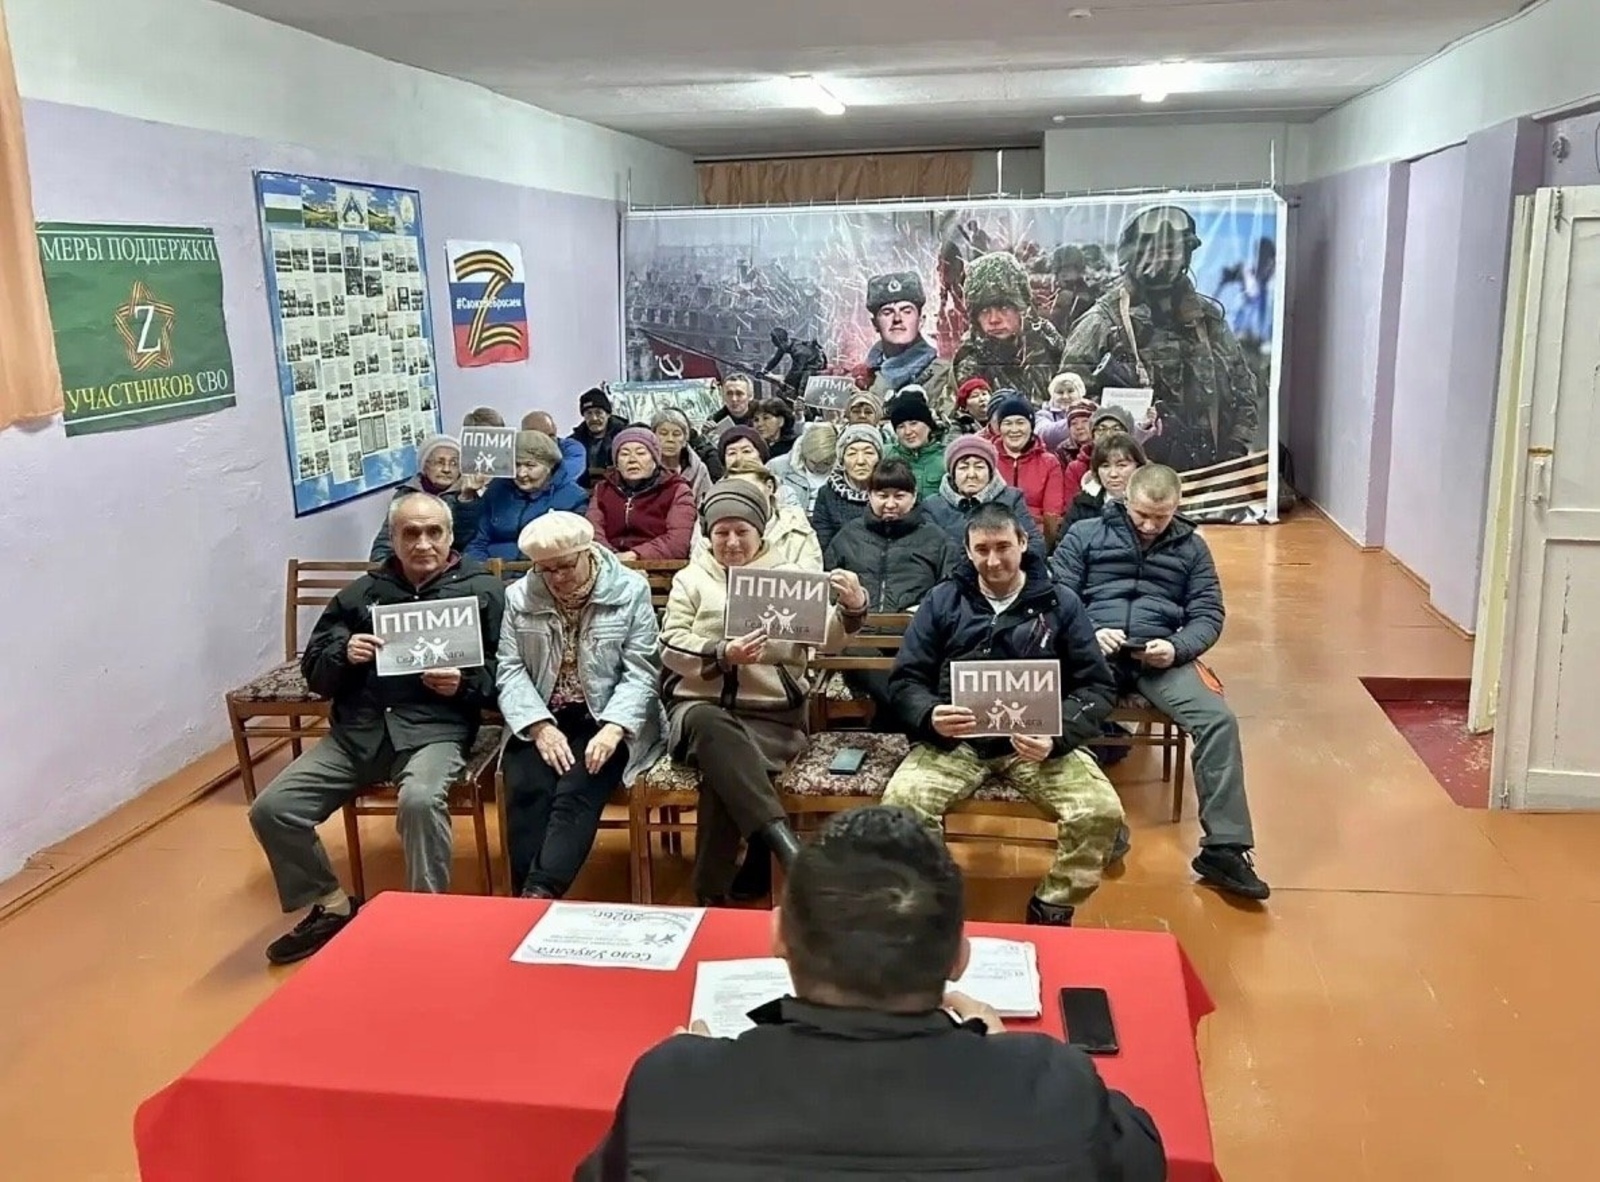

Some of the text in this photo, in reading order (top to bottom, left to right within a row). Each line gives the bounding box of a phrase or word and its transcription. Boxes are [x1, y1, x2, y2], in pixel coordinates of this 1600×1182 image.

[41, 237, 216, 265] МЕРЫ ПОДДЕРЖКИ
[134, 305, 161, 353] Z
[66, 369, 228, 413] УЧАСТНИКОВ СВО
[463, 431, 512, 449] ППМИ
[735, 575, 824, 602] ППМИ
[380, 606, 474, 634] ППМИ
[959, 670, 1054, 692] ППМИ
[610, 951, 653, 962] Село
